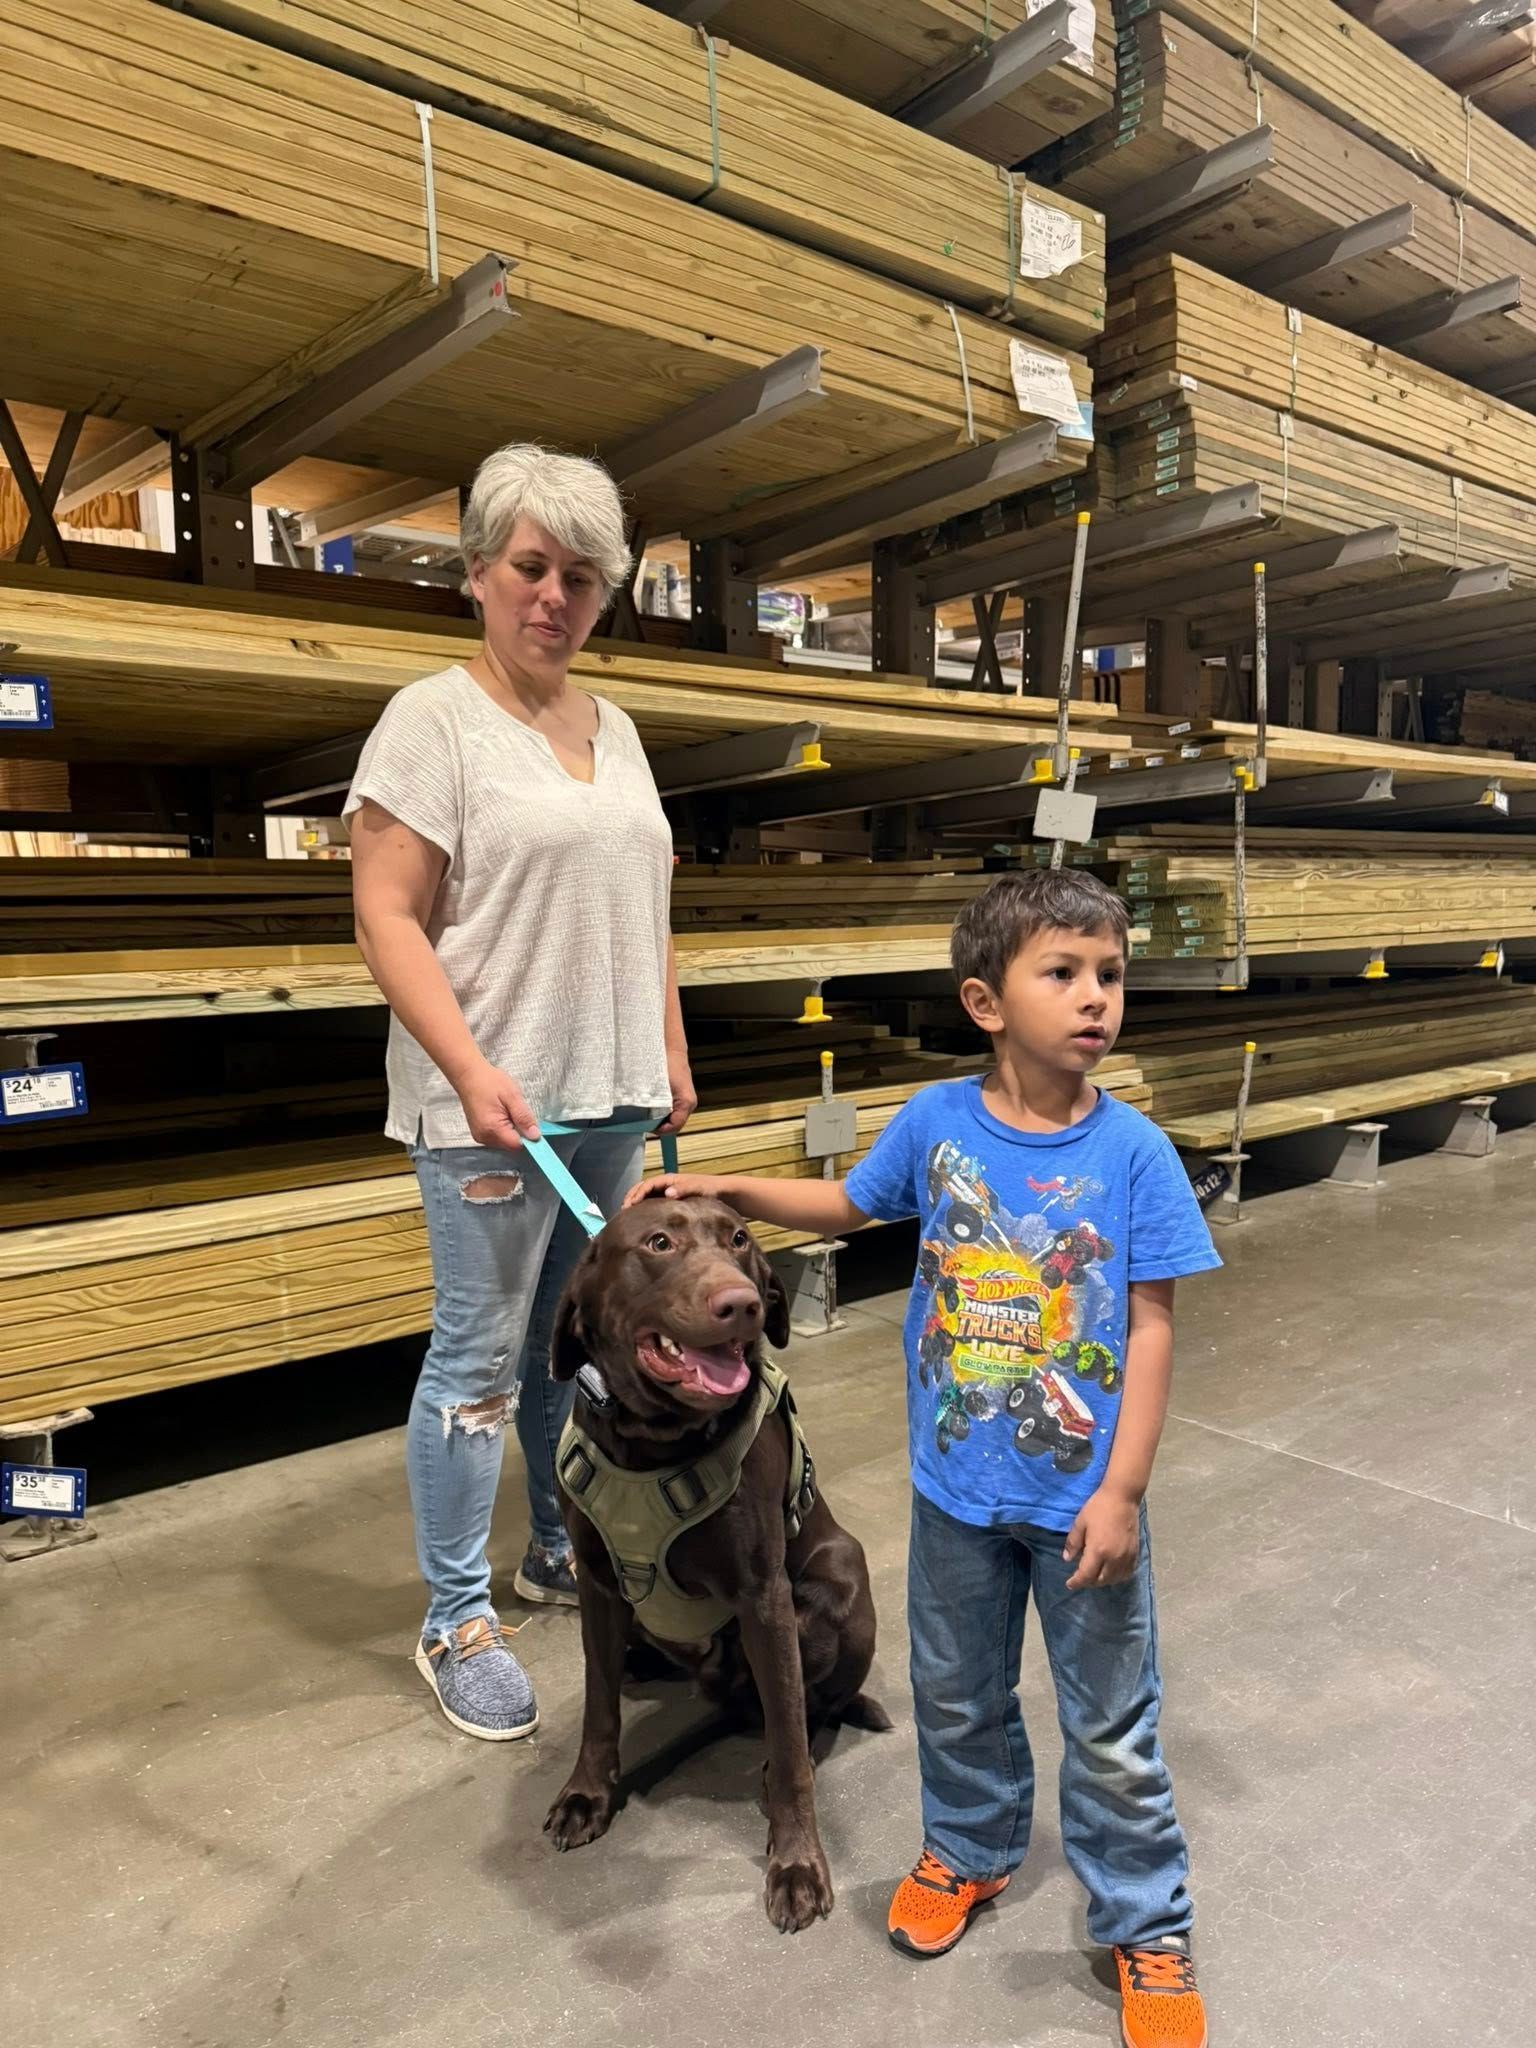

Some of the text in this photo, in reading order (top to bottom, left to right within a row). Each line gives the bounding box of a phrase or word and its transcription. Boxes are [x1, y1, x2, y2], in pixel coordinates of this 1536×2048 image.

[964, 1300, 1041, 1324] MONSTER
[956, 1311, 1042, 1350] TRUCKS
[970, 1338, 1026, 1363] LIVE
[964, 1358, 1027, 1375] GLOW PARTY
